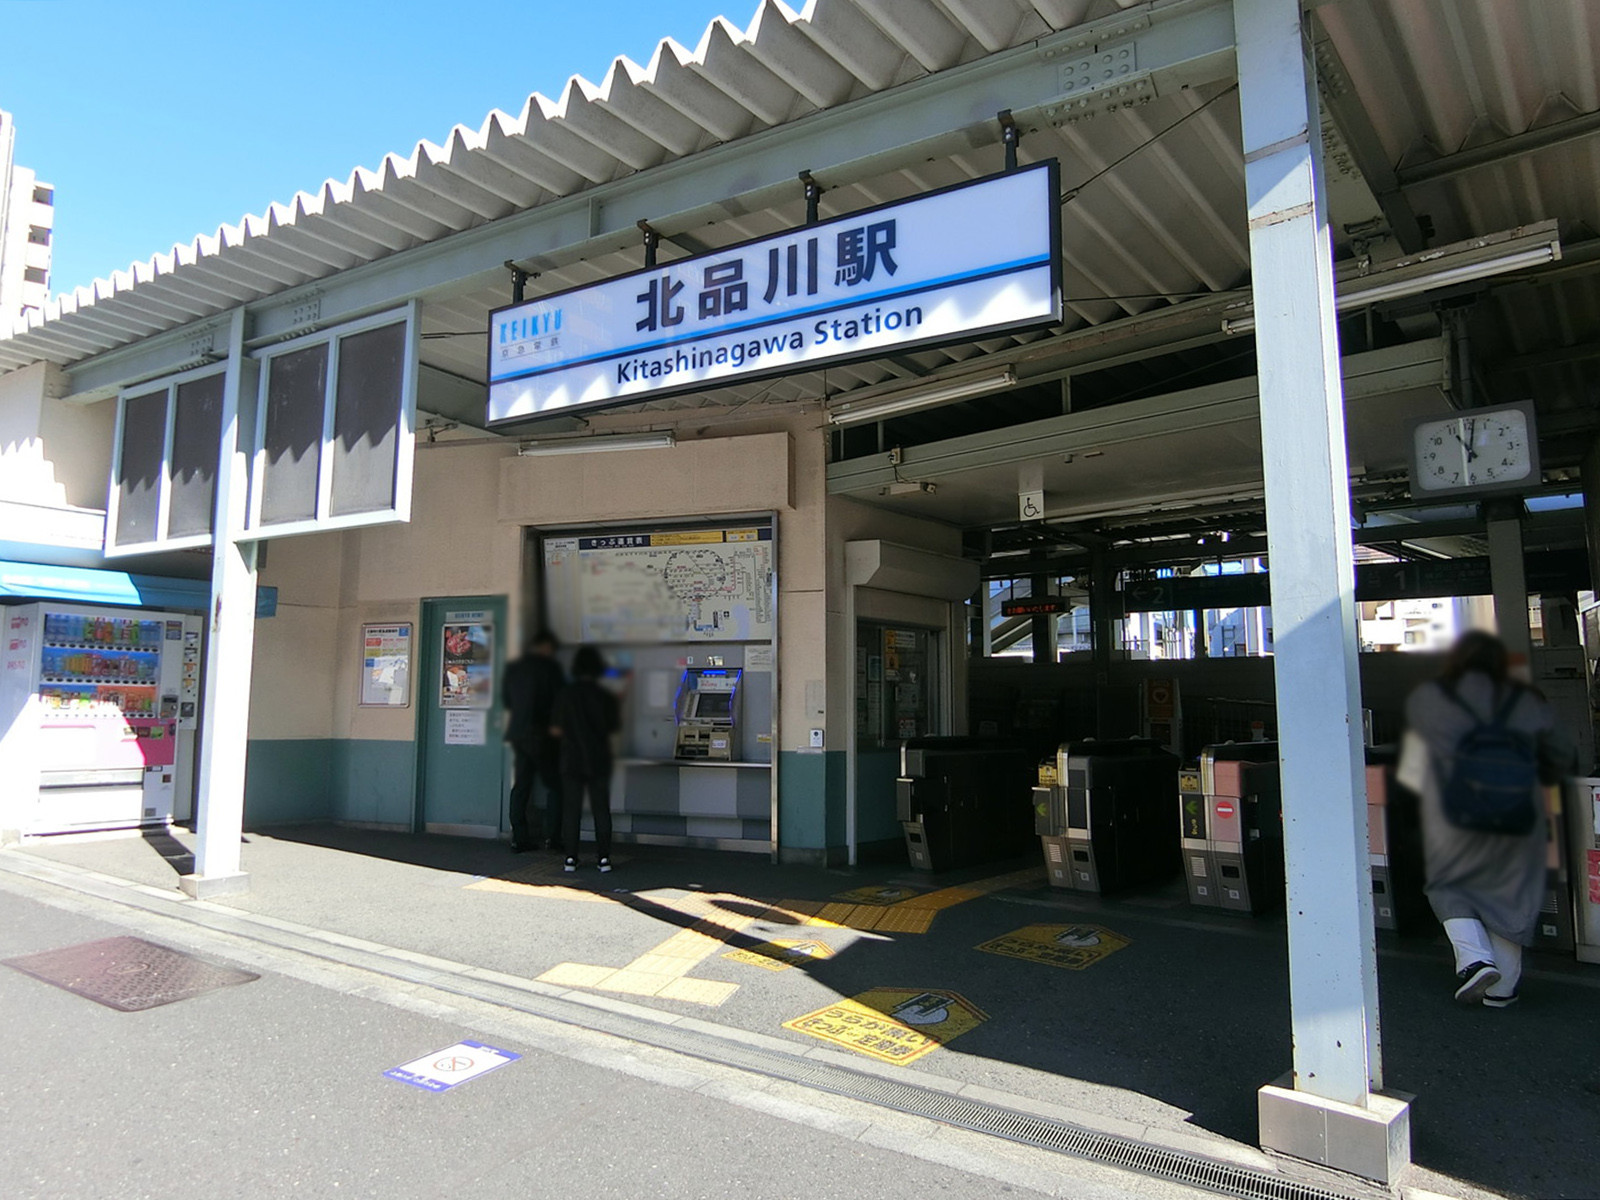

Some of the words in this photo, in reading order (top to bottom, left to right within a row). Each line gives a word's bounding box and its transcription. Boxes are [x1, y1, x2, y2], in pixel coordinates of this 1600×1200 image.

[635, 219, 898, 332] 北品川駅
[500, 309, 562, 344] KEIKYU
[617, 330, 804, 384] Kitashinagawa
[814, 306, 923, 345] Station
[1463, 421, 1473, 431] 12
[1448, 427, 1456, 435] 11
[1498, 428, 1505, 437] 2
[1434, 437, 1443, 446] 10
[1507, 441, 1514, 450] 3
[1429, 452, 1436, 460] 9
[1501, 458, 1508, 466] 4
[1437, 466, 1445, 475] 8
[1487, 468, 1493, 477] 5
[1453, 472, 1459, 480] 7
[1470, 472, 1477, 481] 6
